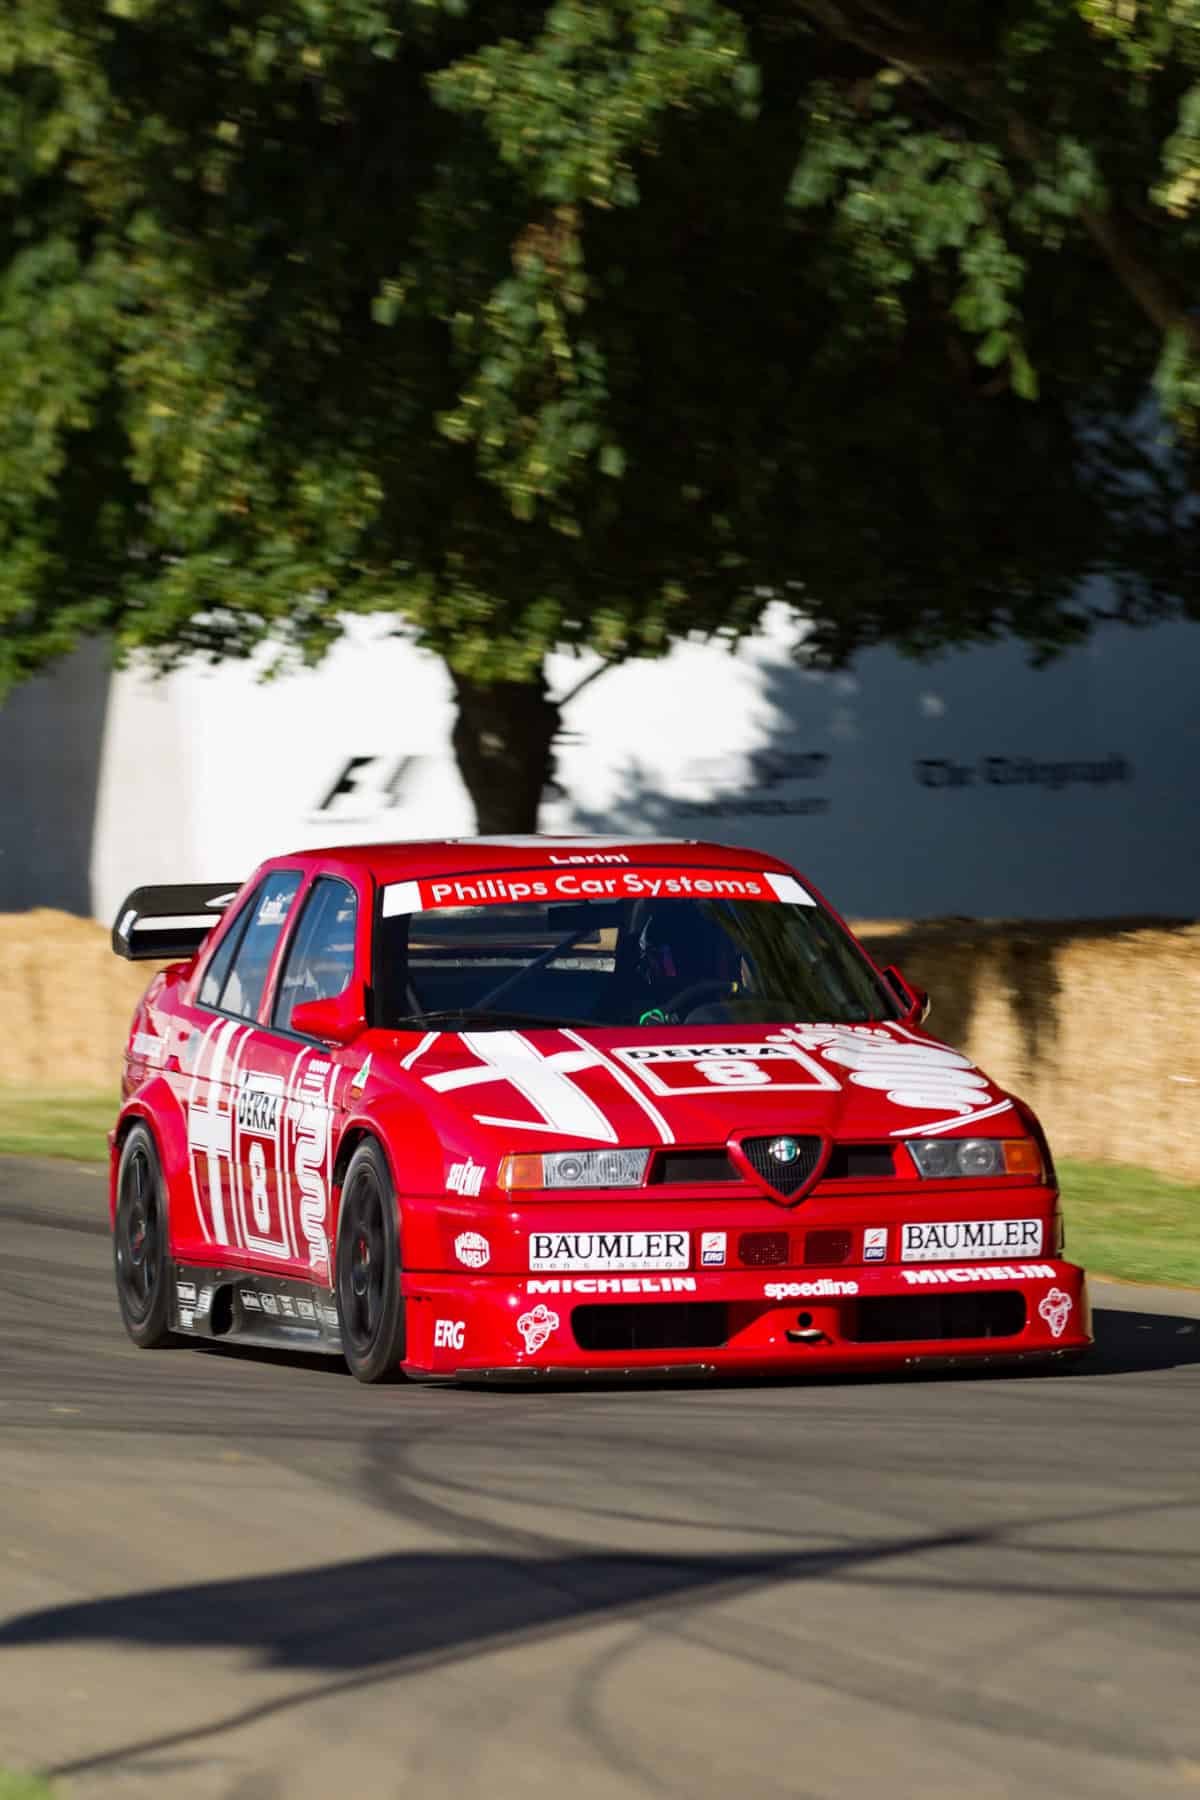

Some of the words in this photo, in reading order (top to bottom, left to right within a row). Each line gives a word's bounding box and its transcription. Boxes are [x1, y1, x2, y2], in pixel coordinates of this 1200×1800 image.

[549, 854, 631, 865] Larini
[431, 876, 548, 903] Philips
[555, 874, 617, 895] Car
[623, 874, 762, 897] Systems
[626, 1045, 790, 1061] DEKRA
[694, 1060, 772, 1086] 8
[238, 1091, 278, 1132] DEKRA
[248, 1141, 271, 1234] 8
[532, 1232, 687, 1259] BÄUMLER
[906, 1221, 1040, 1249] BÄUMLER
[526, 1277, 697, 1294] MICHELIN
[901, 1264, 1057, 1285] MICHELIN
[763, 1278, 860, 1300] speedline
[433, 1319, 466, 1349] ERG
